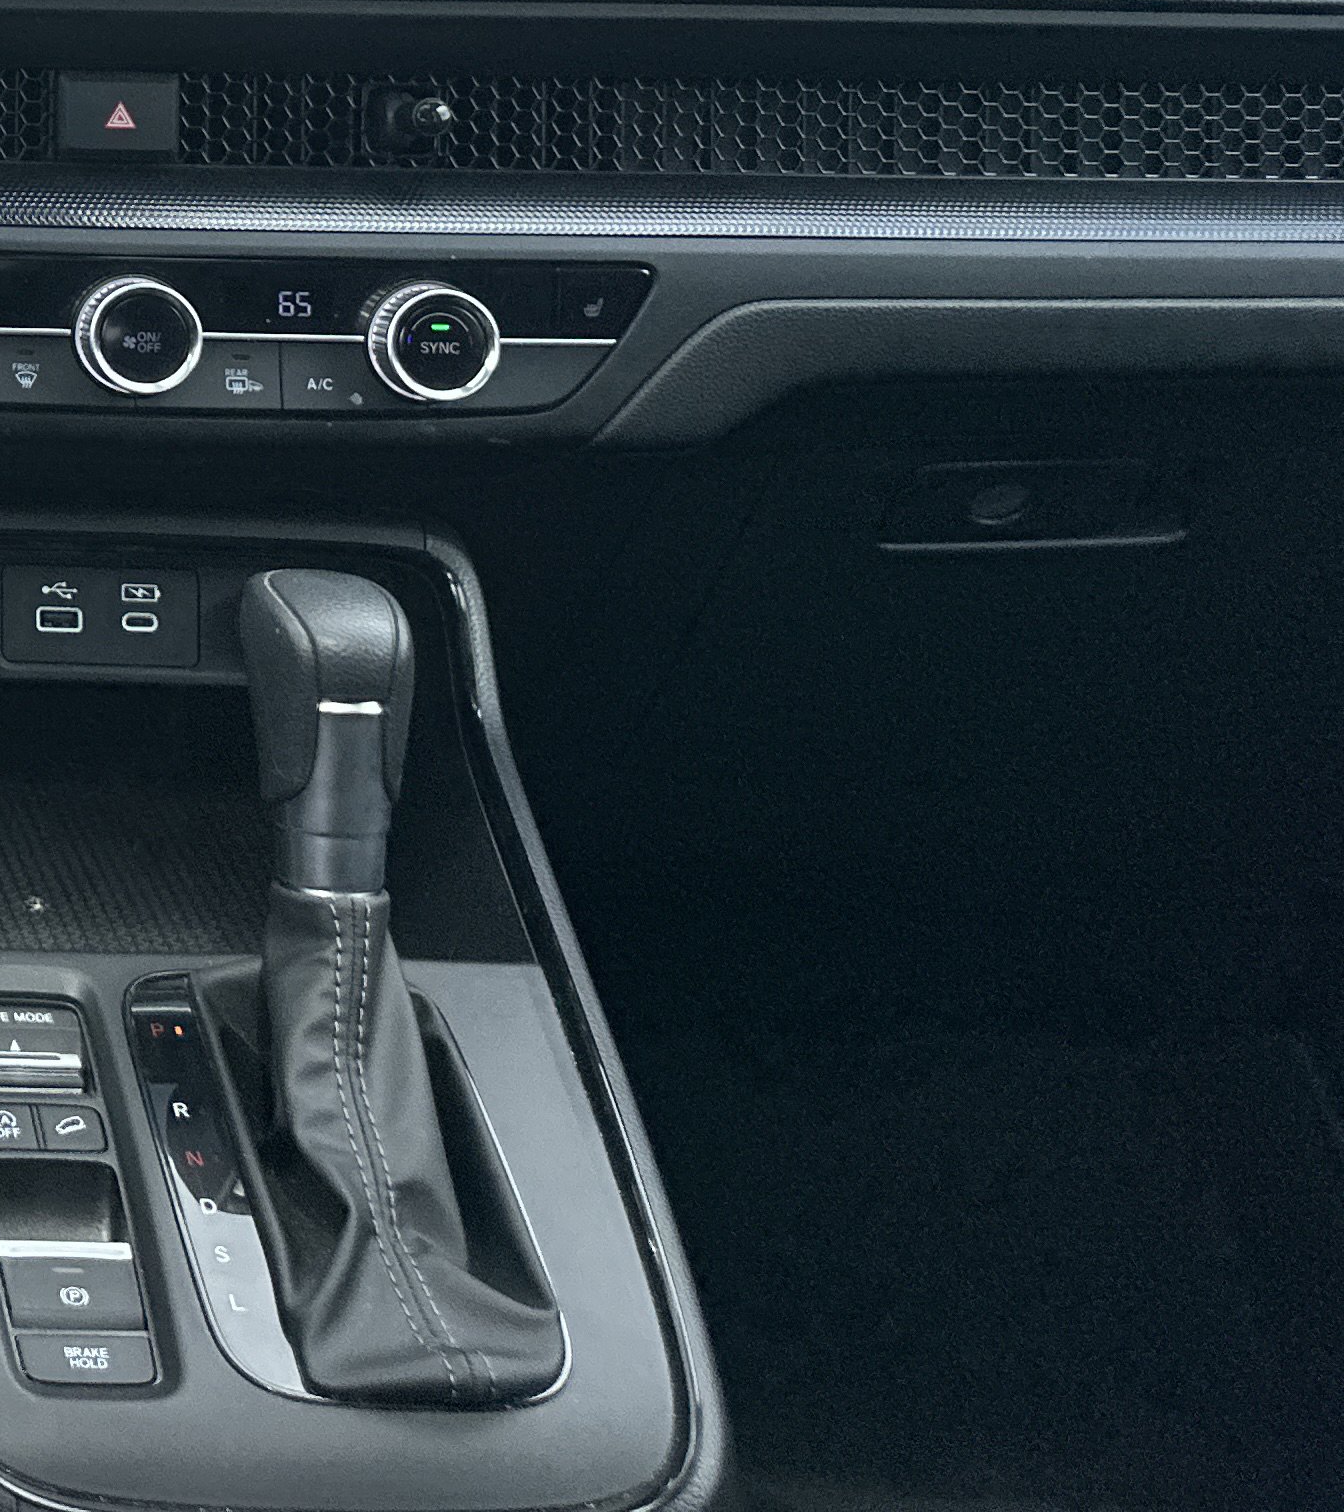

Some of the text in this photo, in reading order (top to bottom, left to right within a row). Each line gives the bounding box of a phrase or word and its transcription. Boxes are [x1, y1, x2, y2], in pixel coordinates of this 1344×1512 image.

[277, 291, 312, 318] 65
[136, 331, 162, 342] ON/
[137, 342, 162, 353] OFF
[419, 340, 461, 357] SYNC
[12, 362, 41, 373] FRONT
[224, 368, 249, 378] REAR
[306, 376, 334, 392] A/C
[14, 1011, 54, 1025] MODE
[150, 1022, 165, 1038] P
[172, 1101, 191, 1119] R
[186, 1150, 205, 1167] N
[199, 1197, 218, 1215] D
[214, 1245, 232, 1264] S
[229, 1293, 247, 1313] L
[63, 1346, 110, 1359] BRAKE
[69, 1357, 109, 1370] HOLD
